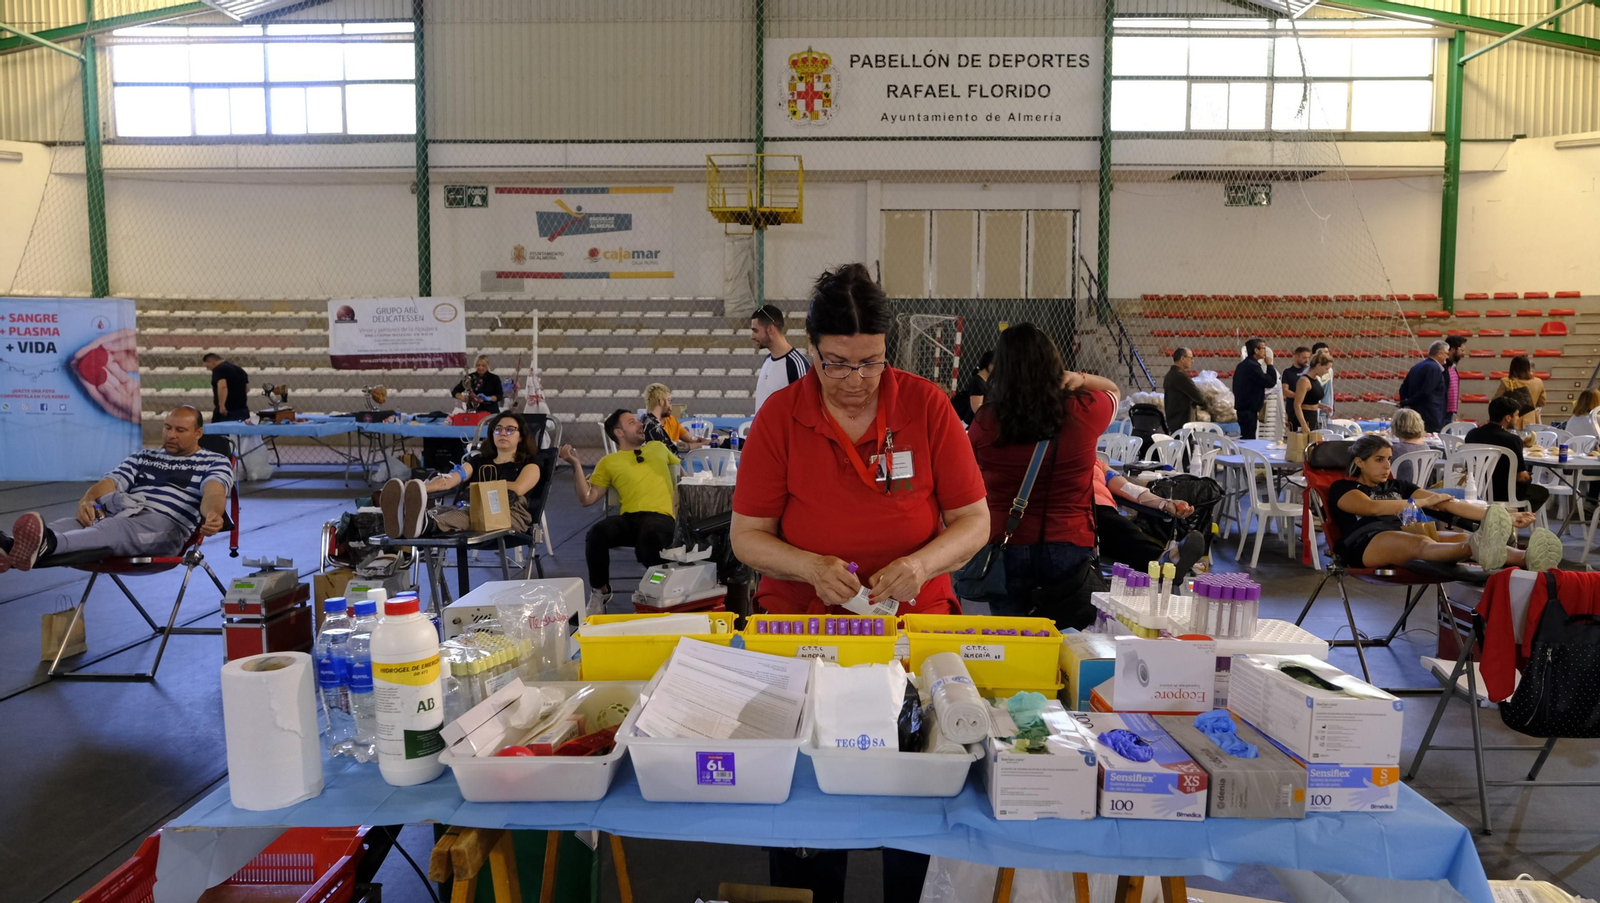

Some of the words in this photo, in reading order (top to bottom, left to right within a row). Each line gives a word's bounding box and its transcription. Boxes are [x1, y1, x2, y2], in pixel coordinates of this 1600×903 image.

[850, 50, 950, 68] PABELLÓN
[958, 54, 982, 68] DE
[989, 53, 1090, 68] DEPORTES
[887, 84, 960, 99] RAFAEL
[968, 84, 1051, 99] FLORIDO
[881, 112, 978, 124] Ayuntamiento
[986, 112, 1001, 122] de
[1008, 112, 1062, 122] Almería
[472, 195, 483, 206] A
[603, 246, 661, 263] cajamar
[8, 313, 59, 323] SANGRE
[372, 315, 425, 323] DELICATESSEN
[8, 326, 60, 337] PLASMA
[17, 341, 57, 354] VIDA
[380, 666, 410, 674] HIDROGEL
[1154, 688, 1206, 703] Ecopore
[416, 697, 435, 714] AB
[706, 759, 725, 771] 6L
[1088, 756, 1094, 764] L
[1109, 772, 1155, 783] Sensiflex
[1309, 768, 1351, 778] Sensiflex
[1380, 768, 1388, 779] S
[1183, 775, 1200, 787] XS
[1110, 799, 1134, 811] 100
[1310, 794, 1332, 806] 100
